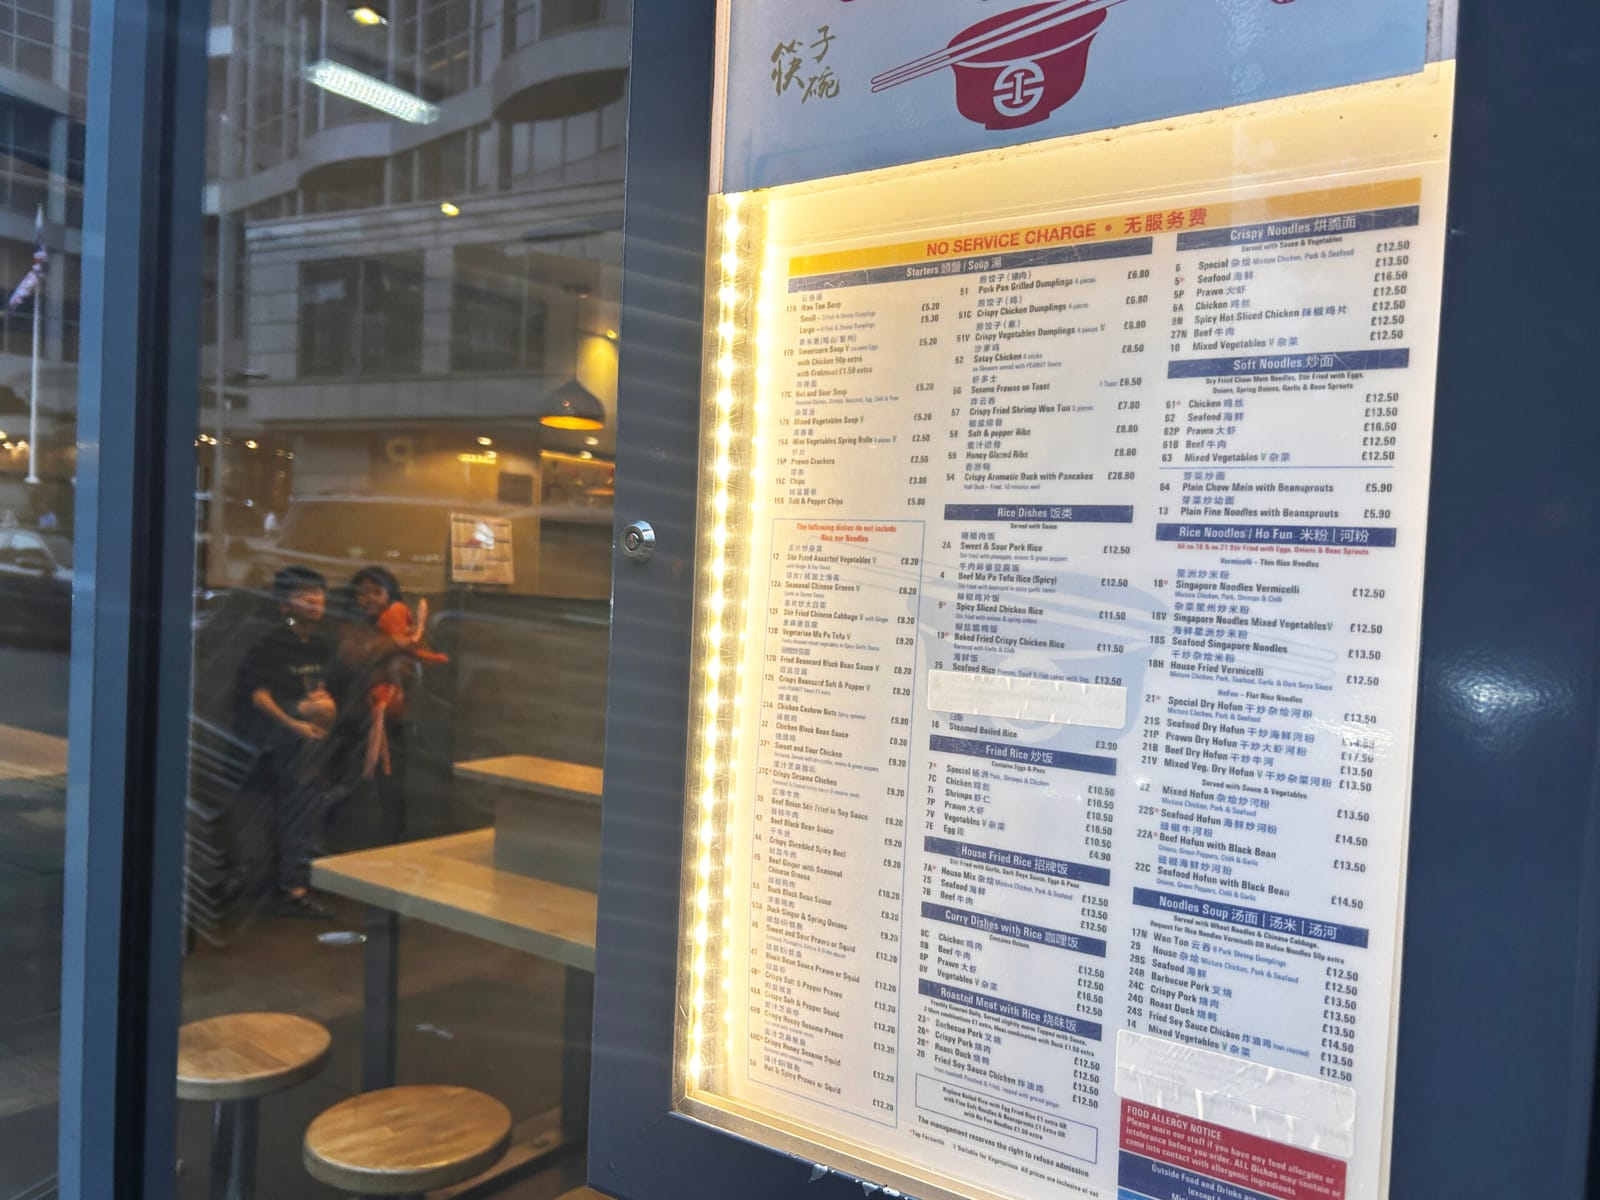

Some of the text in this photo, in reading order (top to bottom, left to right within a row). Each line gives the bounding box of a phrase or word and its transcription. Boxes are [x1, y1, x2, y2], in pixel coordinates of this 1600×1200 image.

[926, 207, 1208, 257] NO SERVICE CHARGE 无服务费
[1230, 227, 1264, 241] Crispy
[1267, 223, 1311, 237] Noodles
[1376, 241, 1410, 252] £12.50
[968, 259, 989, 272] Soup
[1199, 259, 1229, 271] Special
[1375, 255, 1409, 267] £13.50
[907, 266, 938, 277] Starters
[1374, 271, 1408, 282] £16.50
[1198, 273, 1231, 284] Seafood
[1196, 287, 1223, 296] Prawn
[1373, 285, 1407, 296] £12.50
[1029, 303, 1066, 314] Dumplings
[1195, 300, 1228, 311] Chicken
[1194, 308, 1299, 326] Spicy Hot Sliced Chicken
[1194, 328, 1212, 338] Beef
[1370, 330, 1403, 341] £12.50
[1170, 338, 1266, 352] 10 Mixed Vegetables
[995, 353, 1022, 362] Chicken
[1234, 354, 1333, 371] Soft Noodles 炒面
[1119, 377, 1142, 386] £6.50
[1366, 392, 1399, 402] £12.50
[1012, 405, 1037, 415] Shrimp
[1188, 413, 1221, 422] Seafood
[1187, 426, 1214, 436] Prawn
[1364, 422, 1397, 432] £16.50
[1186, 440, 1205, 449] Beef
[1162, 453, 1258, 464] 63 Mixed Vegetables
[965, 473, 985, 483] Crispy
[1182, 483, 1334, 494] Plain Chow Mein with Beansprouts
[1366, 483, 1392, 493] £5.90
[997, 508, 1072, 519] Rice Dishes 饭类
[1158, 507, 1339, 520] 13 Plain Fine Noodles with Beansprouts
[1364, 509, 1391, 519] £5.90
[1179, 527, 1369, 543] Rice Noodles Ho Fun 米粉 河粉
[1027, 544, 1042, 552] Rice
[1103, 545, 1130, 554] £12.50
[1176, 580, 1300, 594] Singapore Noodles Vermicelli
[1352, 588, 1385, 599] £12.50
[956, 603, 1043, 615] Spicy Sliced Chicken Rice
[1099, 611, 1126, 620] £11.50
[955, 633, 1064, 648] Baked Fried Chicken Rice
[1172, 637, 1288, 654] Seafood Singapore Noodles
[1348, 649, 1381, 660] £13.50
[1170, 661, 1264, 677] House Fried Vermicelli
[1168, 696, 1243, 712] Special Dry Hofun
[986, 745, 1053, 764] Fried Rice 炒饭
[1088, 785, 1114, 796] £10.50
[1339, 780, 1372, 792] £13.50
[945, 801, 966, 811] Prawn
[1159, 832, 1276, 859] Beef Hofun with Black Bean
[1335, 834, 1368, 847] £14.50
[962, 845, 1068, 876] House Fried Rice 招牌饭
[1159, 896, 1338, 940] Noodles Soup 汤面 汤米 汤河
[945, 911, 968, 926] Curry
[971, 915, 998, 931] Dishes
[1001, 924, 1021, 937] with
[1023, 928, 1042, 940] Rice
[1131, 941, 1141, 950] 29
[1078, 965, 1104, 978] £12.50
[1326, 967, 1359, 982] £12.50
[1151, 971, 1210, 993] Barbecue Pork
[1151, 985, 1197, 1004] Crispy Pork
[941, 987, 1077, 1033] Roasted Meat with Rice 烧味饭
[1150, 998, 1195, 1017] Roast Duck
[935, 1032, 956, 1045] Crispy
[1321, 1038, 1354, 1053] £14.50
[1074, 1057, 1100, 1071] £12.50
[1073, 1082, 1099, 1096] £13.50
[1127, 1105, 1222, 1140] FOOD ALLERGY NOTICE
[1056, 1158, 1089, 1177] admission
